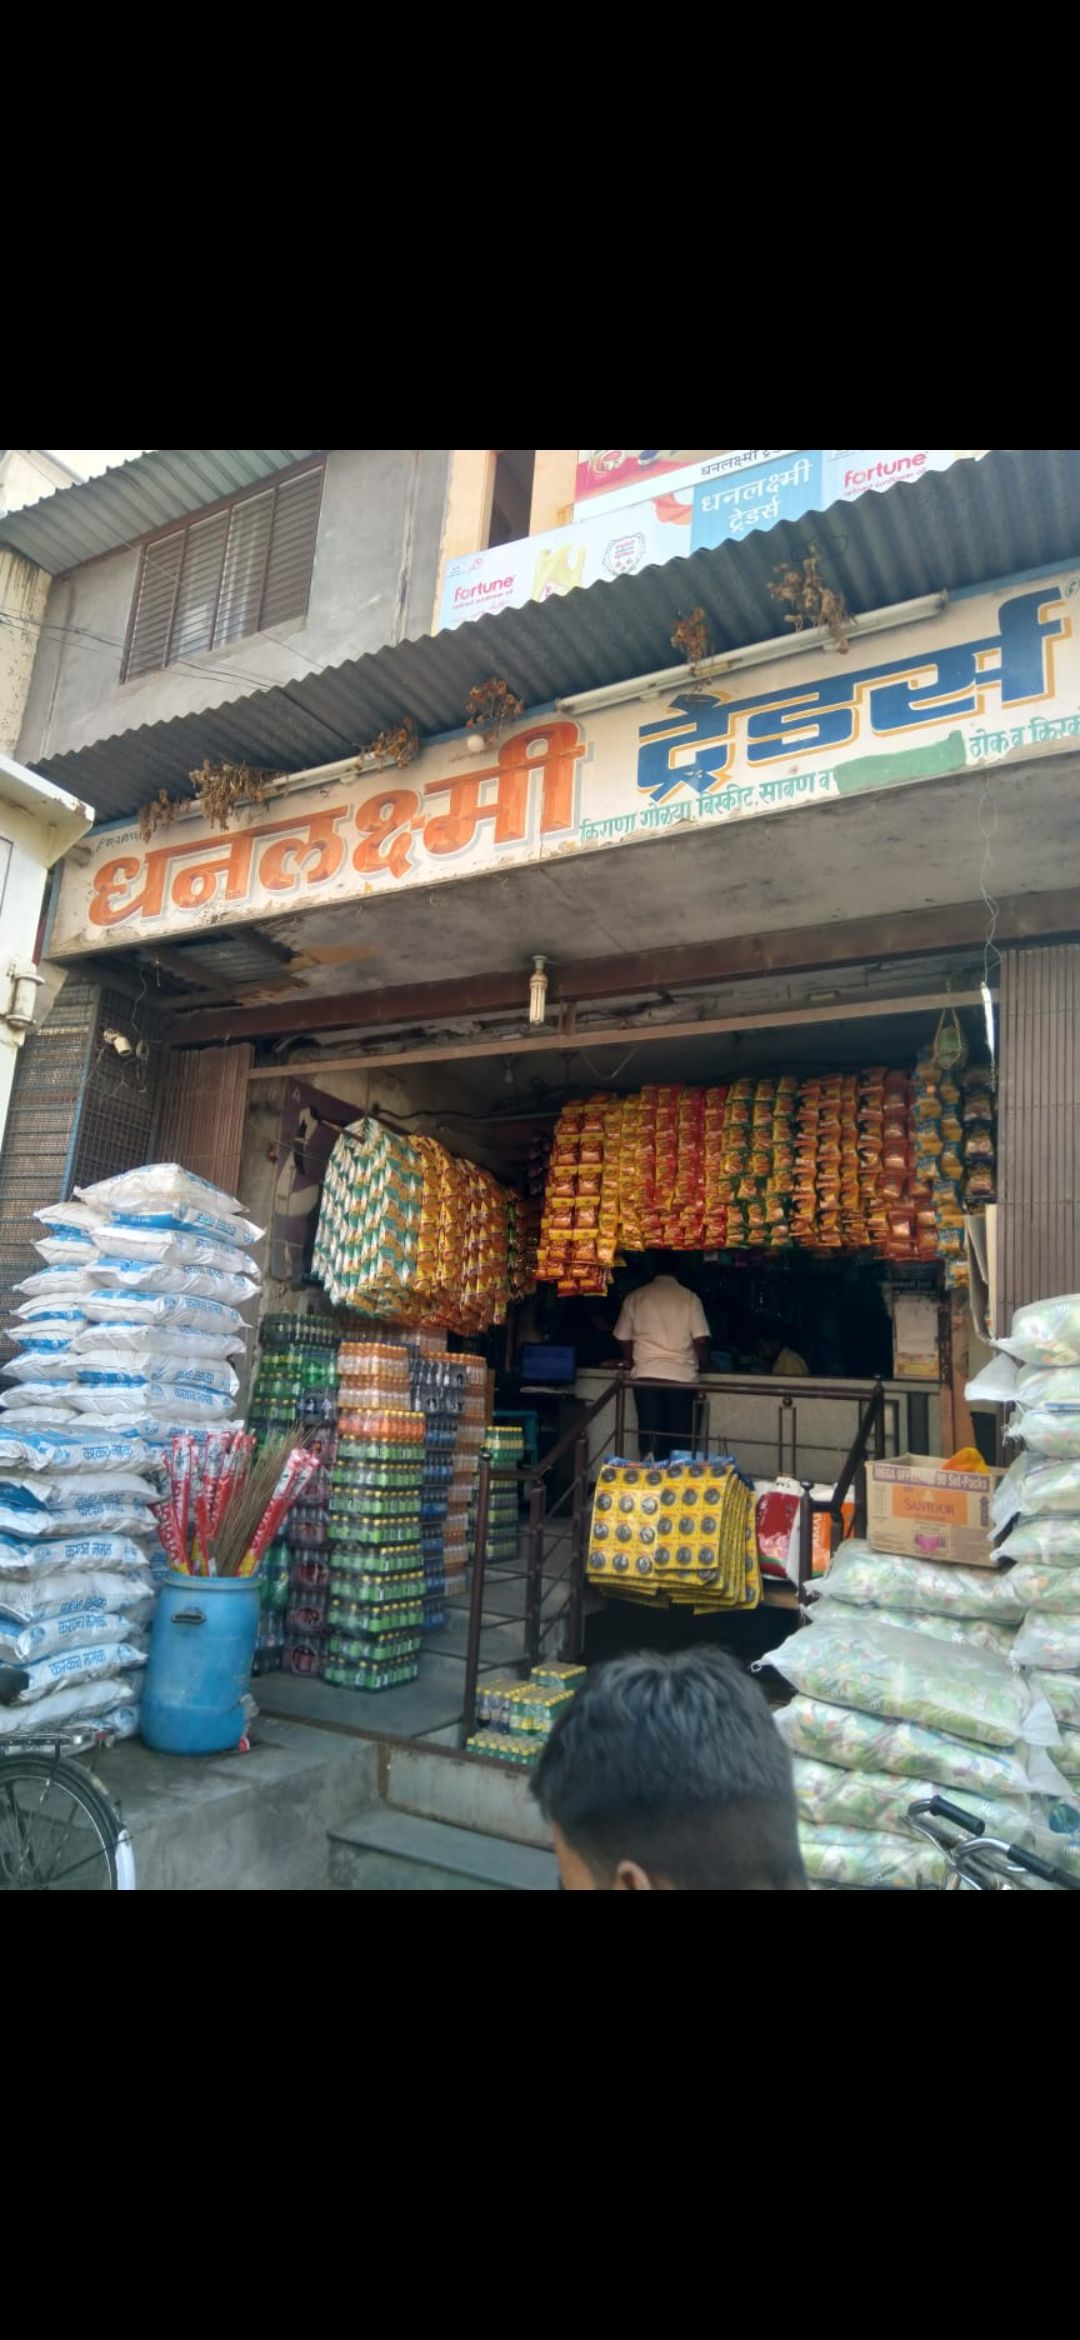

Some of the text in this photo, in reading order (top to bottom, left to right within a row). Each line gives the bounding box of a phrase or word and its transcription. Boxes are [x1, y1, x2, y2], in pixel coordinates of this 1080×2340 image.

[701, 459, 813, 512] धनलक्ष्मी
[844, 452, 927, 489] fortune
[728, 495, 780, 532] ट्रेडर्स
[454, 576, 514, 603] fortune
[87, 586, 1071, 927] धनलक्ष्मी ट्रेडर्स
[579, 818, 636, 844] किराणा
[759, 772, 816, 804] साबण
[969, 728, 1009, 757] ठोक
[1010, 727, 1025, 747] व
[903, 1496, 956, 1514] SANTOOR
